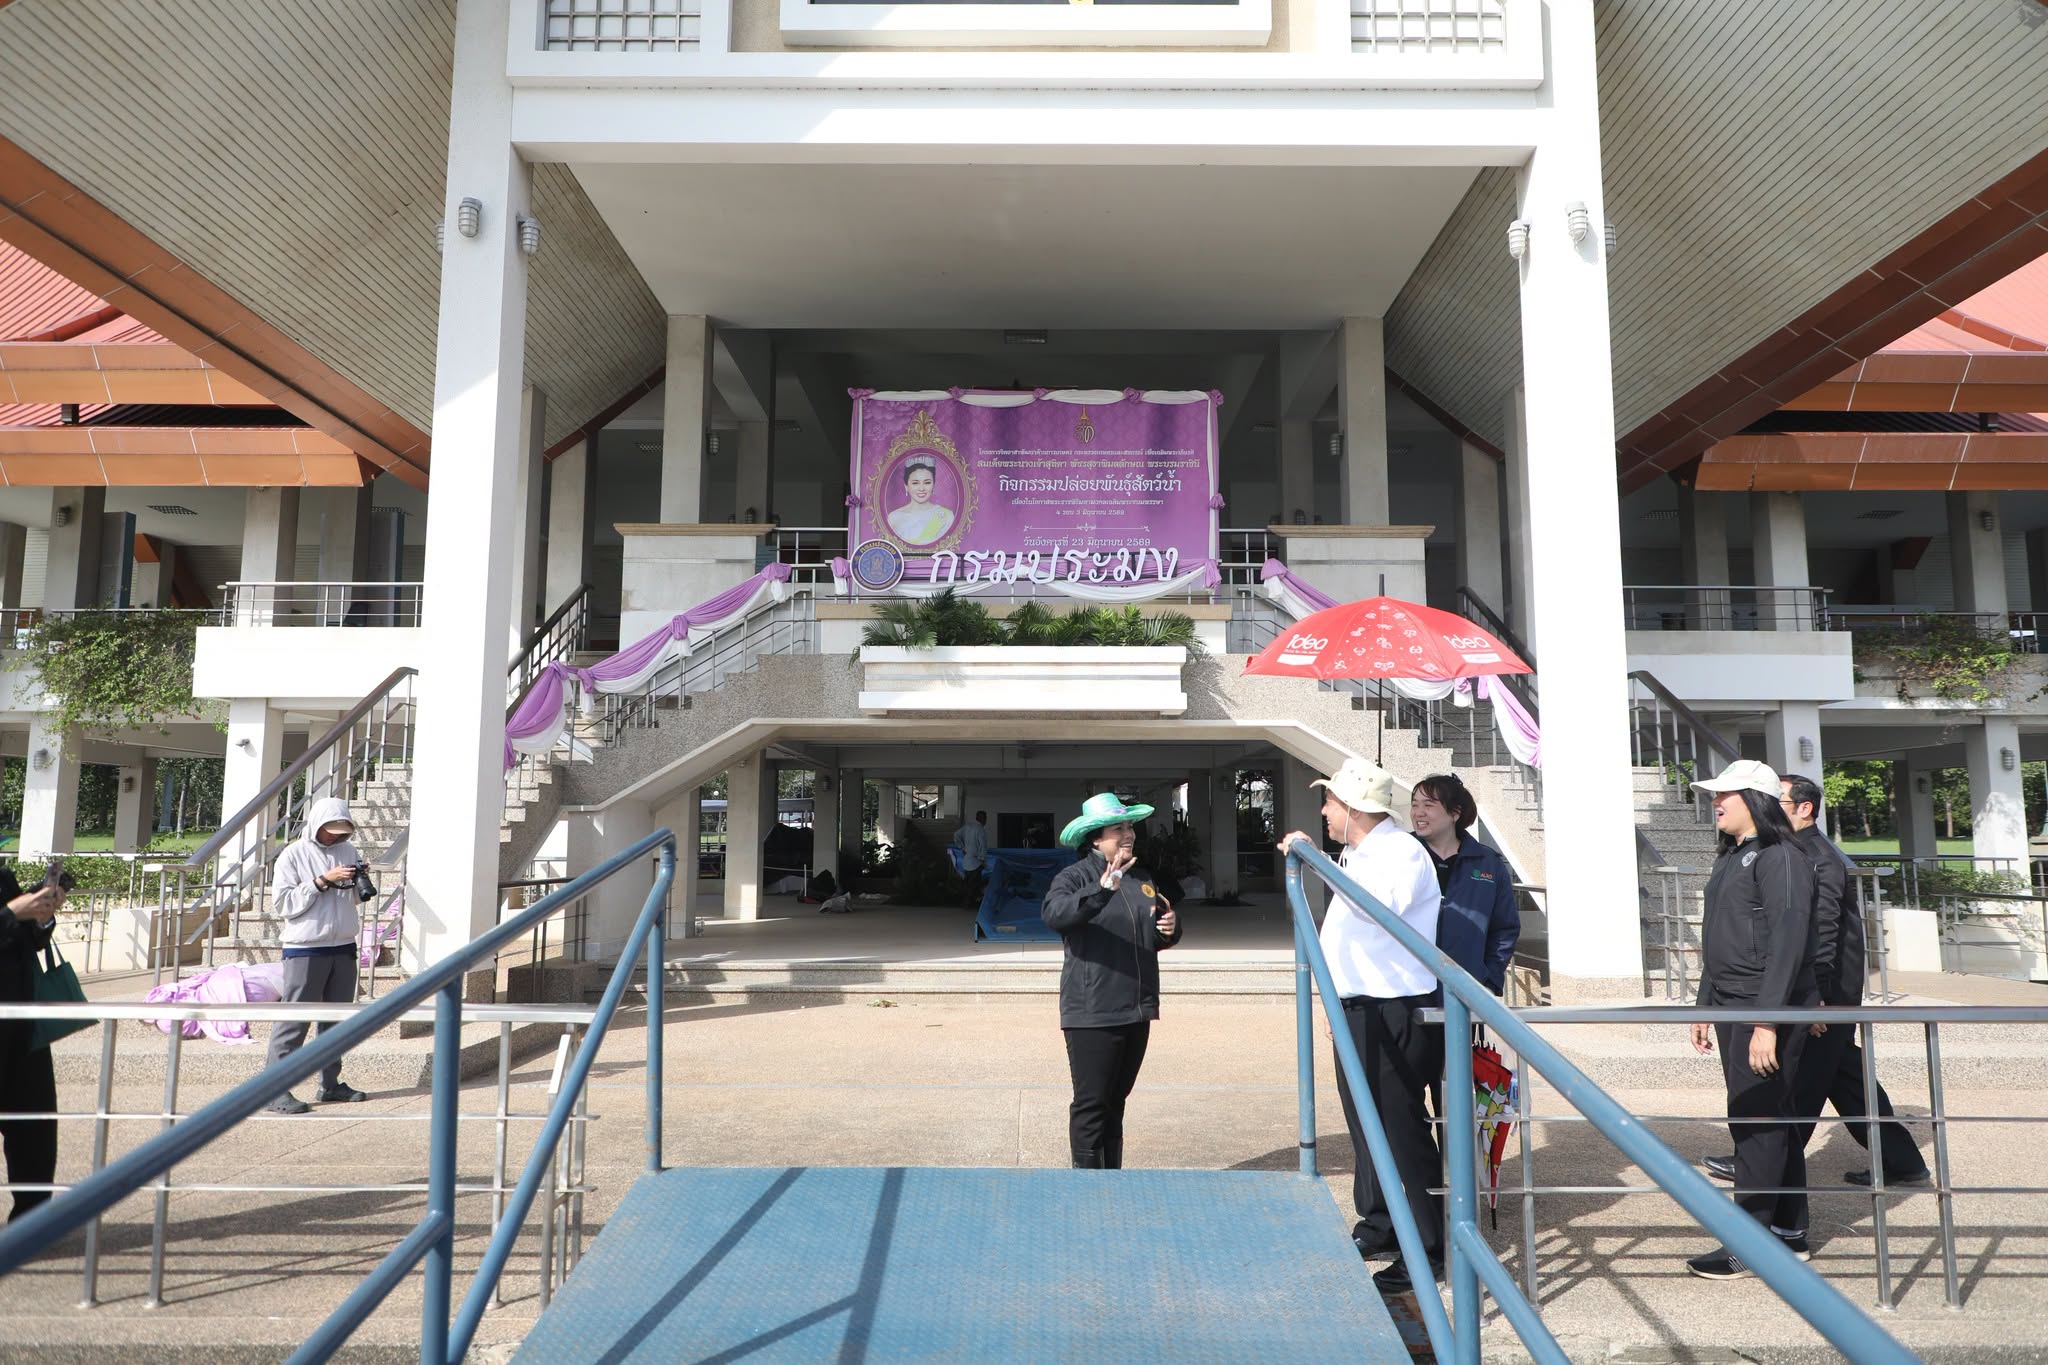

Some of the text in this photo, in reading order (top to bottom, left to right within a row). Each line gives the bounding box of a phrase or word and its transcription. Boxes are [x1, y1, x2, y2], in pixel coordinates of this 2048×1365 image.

[977, 457, 1067, 470] สมเด็จพระนางเจ้าสุทิดา
[1147, 458, 1201, 469] พระบรมราชินี
[999, 469, 1182, 497] กิจกรรมปล่อยพันธุ์สัตว์น้ำ
[1023, 535, 1151, 549] วันอังคารที่ 23 มิถุนายน 2569
[929, 544, 1179, 585] กรมประมง
[1286, 633, 1329, 650] idea
[1442, 634, 1491, 649] idea
